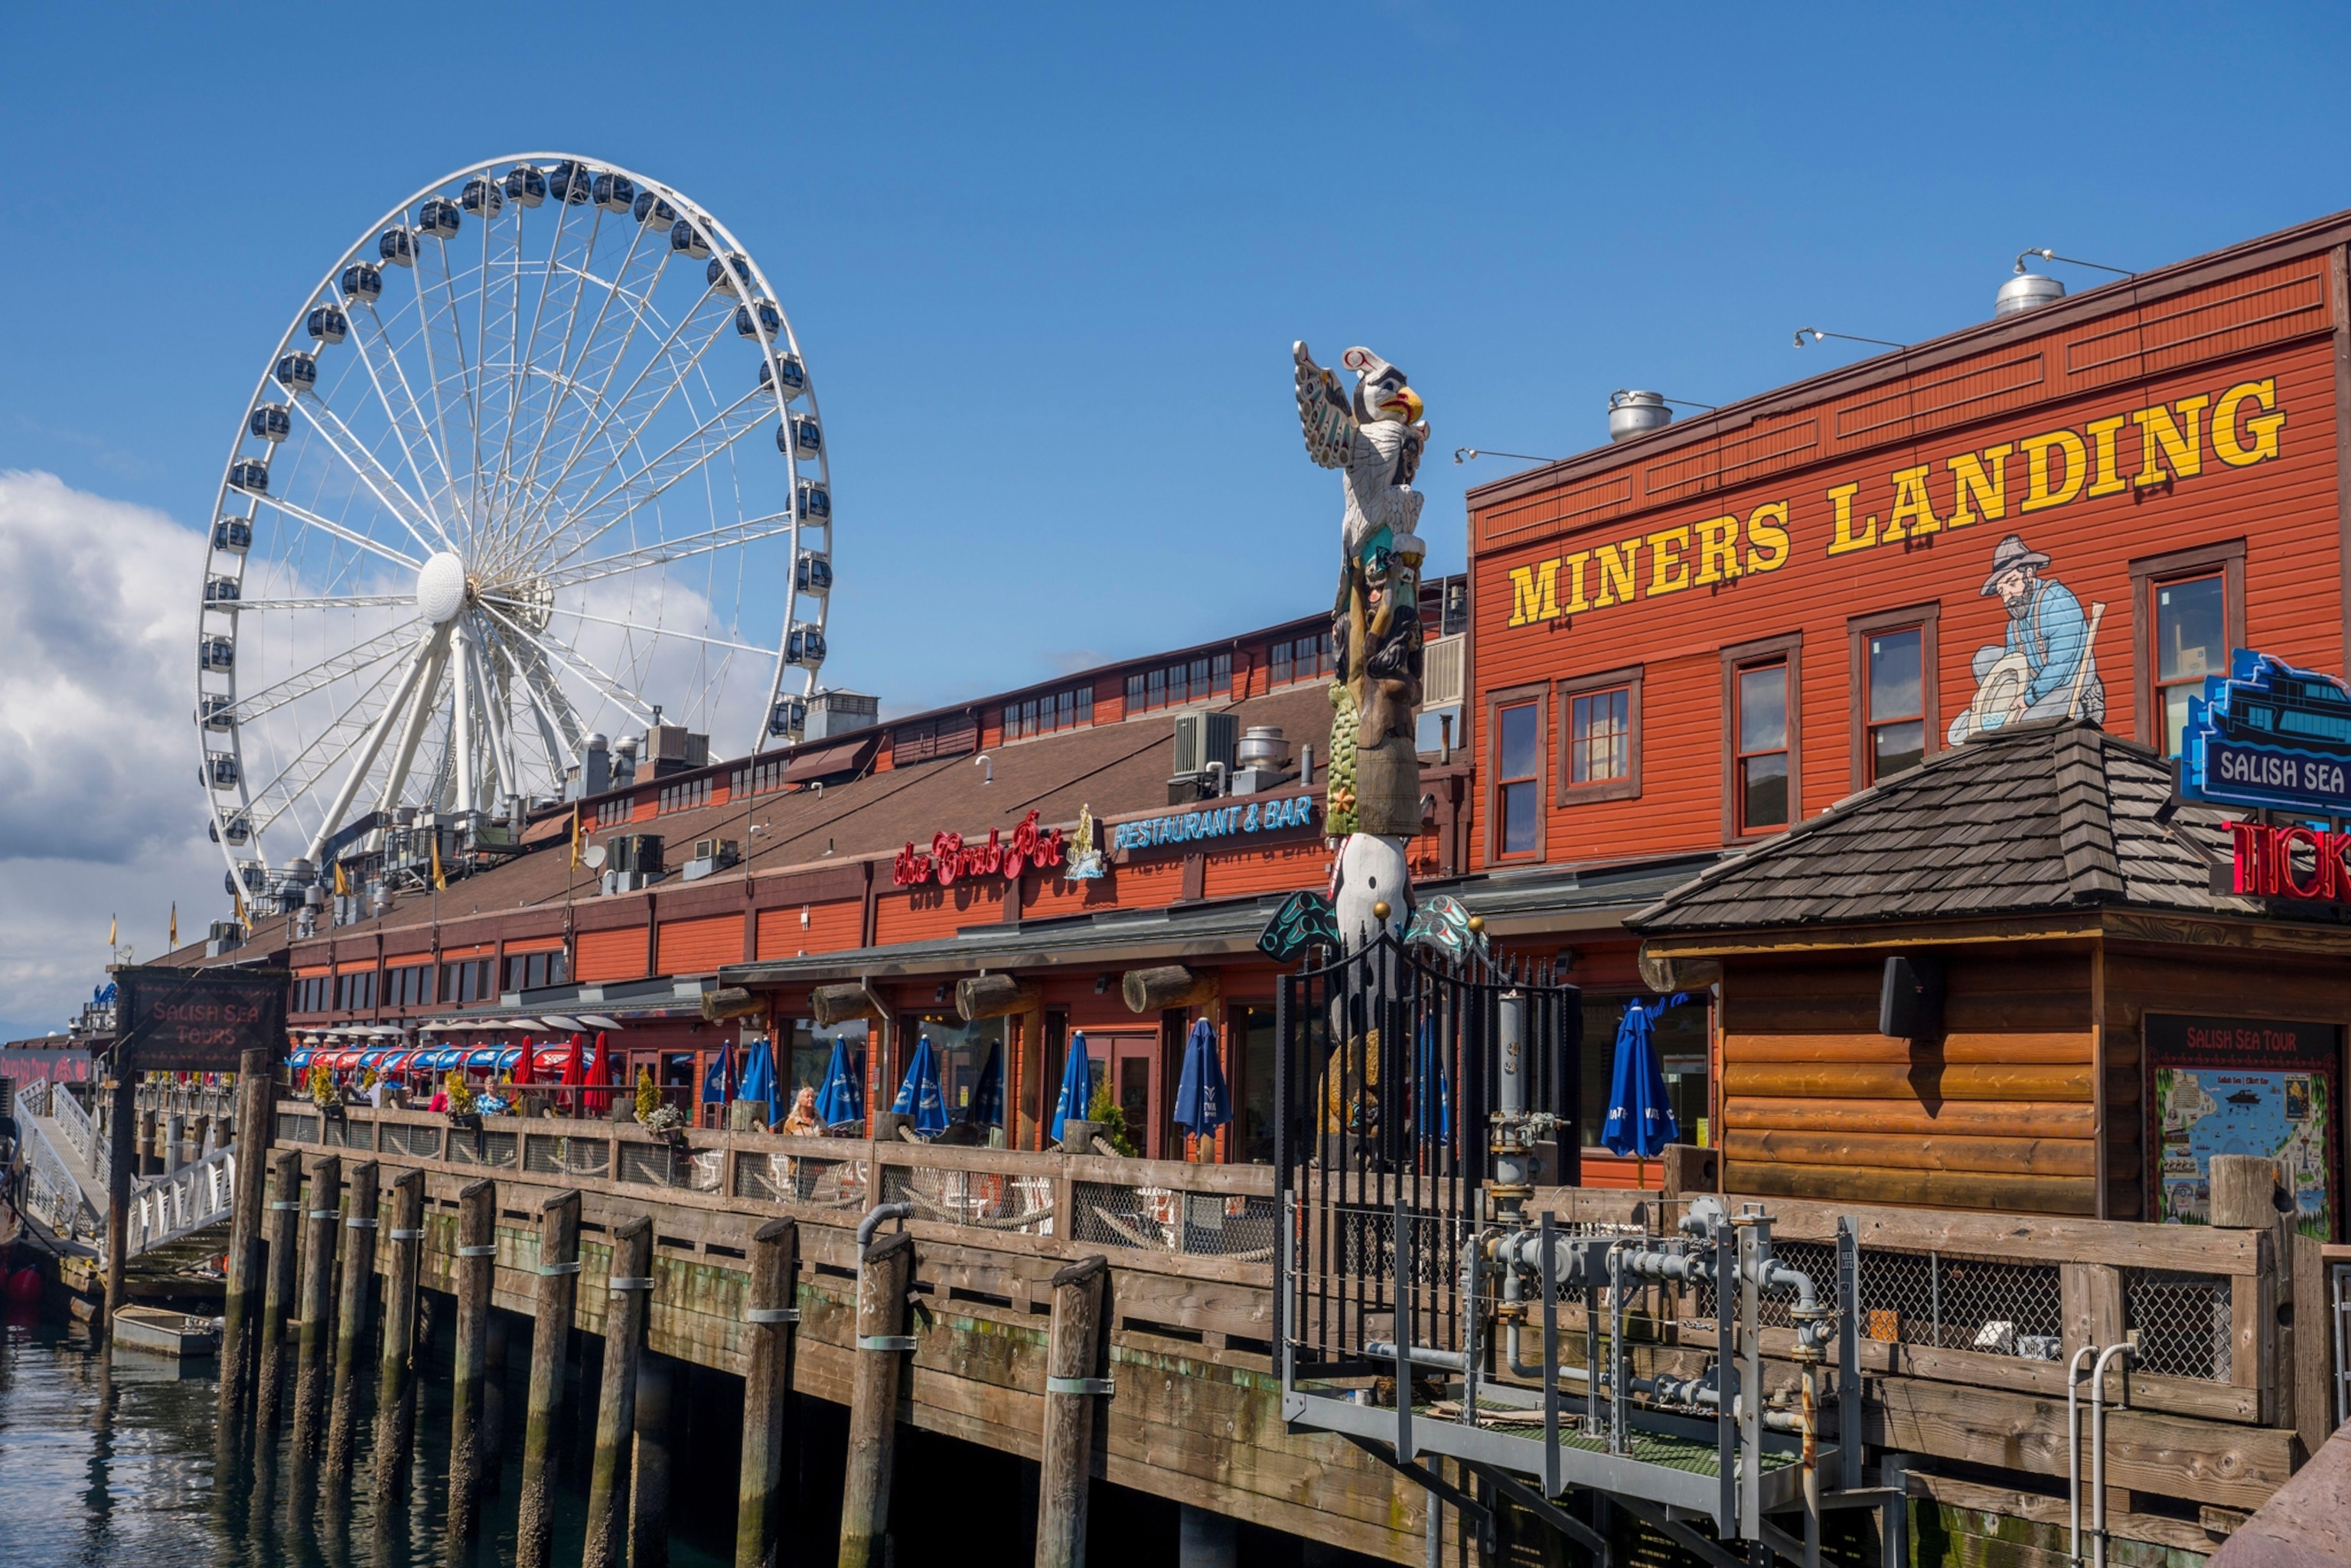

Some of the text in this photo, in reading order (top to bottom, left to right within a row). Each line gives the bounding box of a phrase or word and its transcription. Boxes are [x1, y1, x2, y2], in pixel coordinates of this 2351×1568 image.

[1508, 377, 2287, 630] MINERS LANDING
[2220, 751, 2346, 794] SALISH SEA
[1114, 795, 1312, 850] RESTAURANT & BAR
[892, 809, 1065, 886] the Crab Pot
[153, 1001, 259, 1023] SALISH SEA
[175, 1025, 236, 1045] TOURS
[2186, 1026, 2297, 1052] SALISH SEA TOUR
